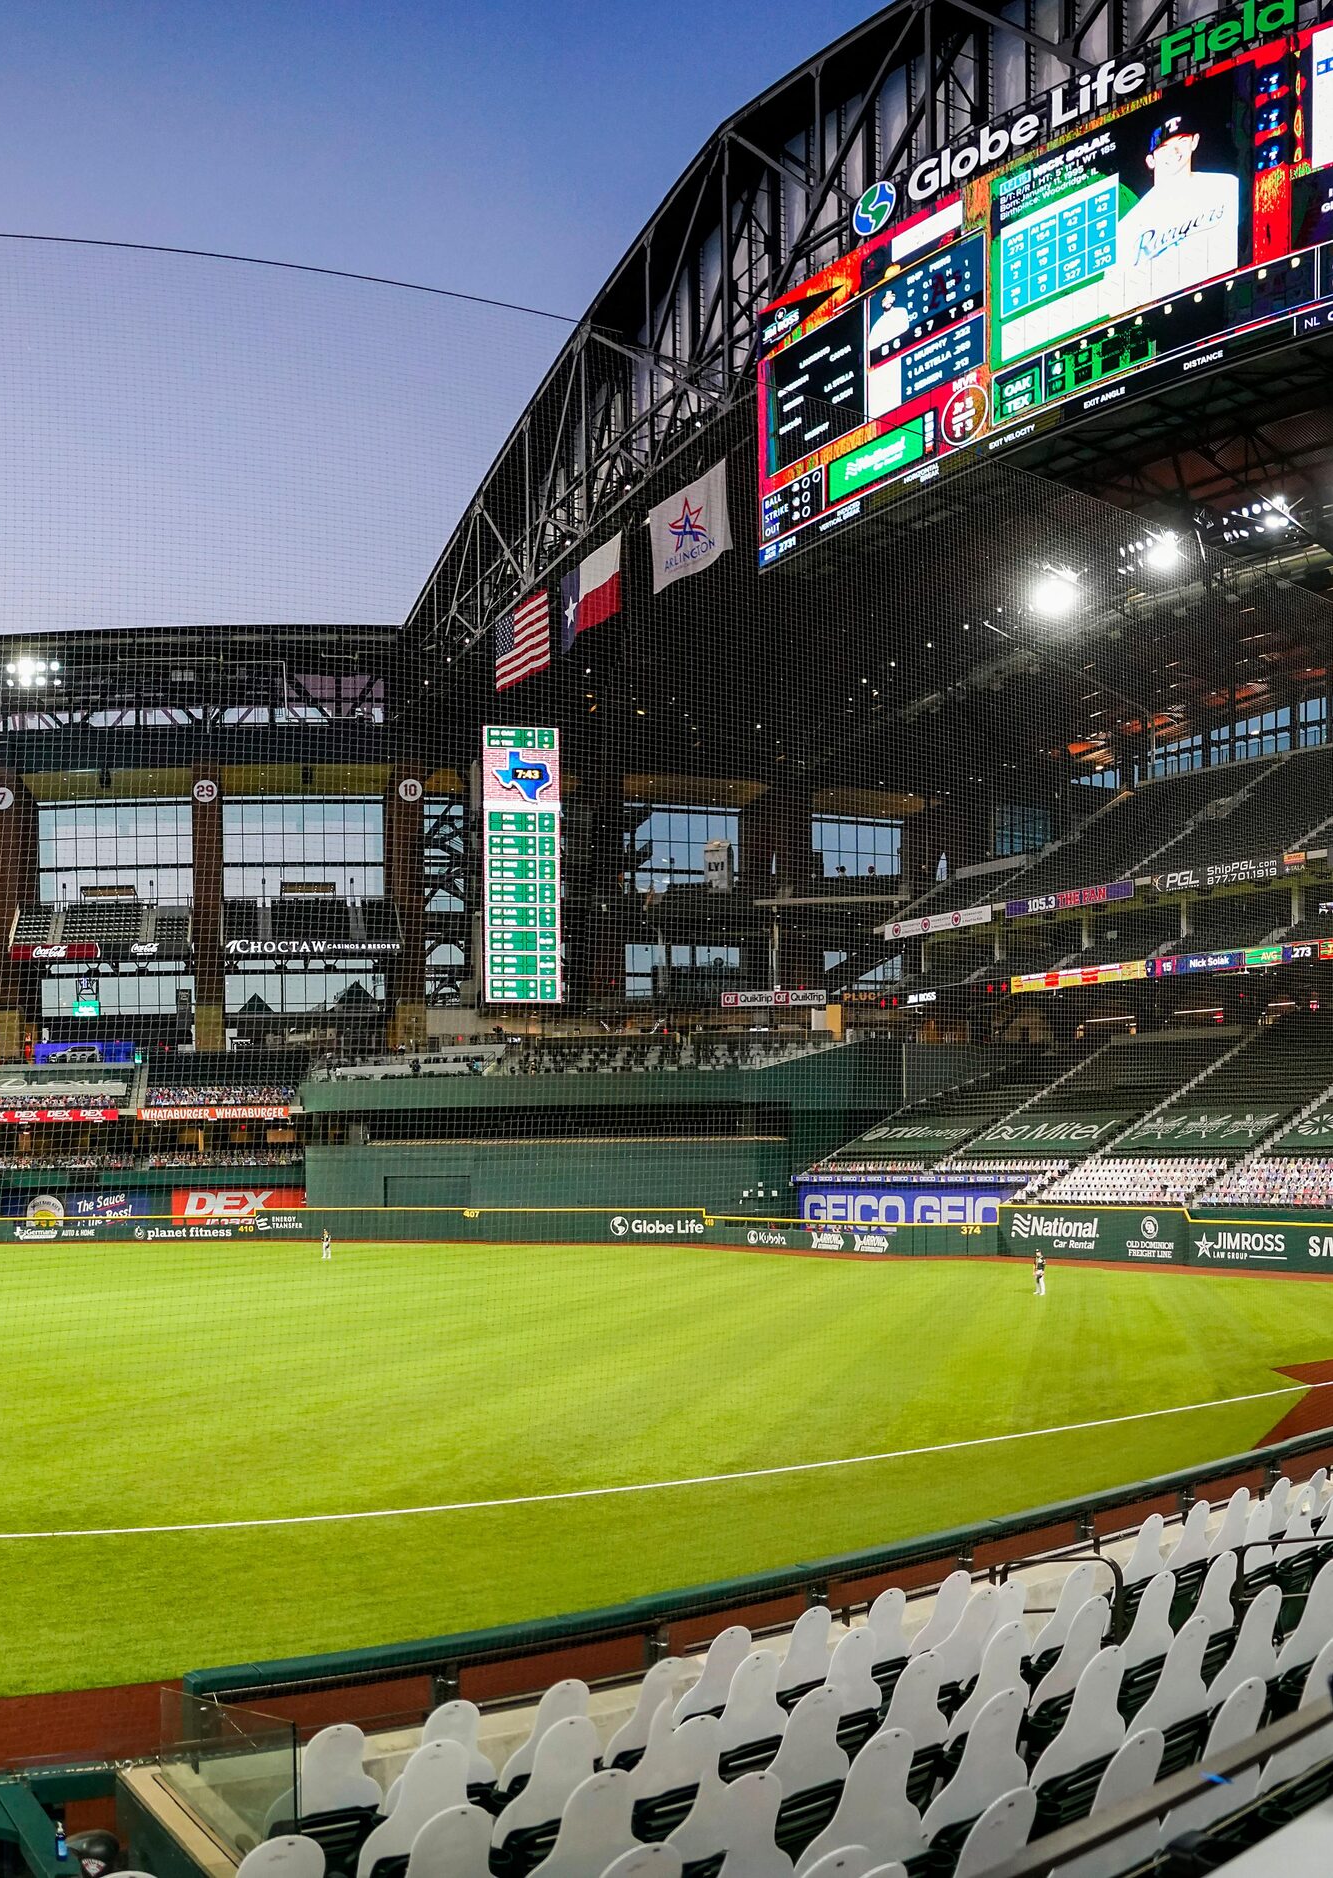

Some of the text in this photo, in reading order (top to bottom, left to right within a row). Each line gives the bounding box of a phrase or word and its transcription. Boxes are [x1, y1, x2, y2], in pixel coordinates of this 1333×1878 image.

[907, 0, 1296, 202] Globe Life Field
[1033, 132, 1111, 177] NICK SOLAK
[1022, 166, 1085, 205] January 1995
[1093, 255, 1112, 269] .370
[1063, 268, 1082, 283] .327
[914, 337, 948, 362] MURPHY
[924, 352, 952, 371] STELLA
[1183, 350, 1224, 371] DISTANCE
[952, 371, 979, 392] MVR
[1004, 375, 1033, 398] OAK
[1005, 394, 1030, 412] TEX
[1099, 387, 1126, 404] ANGLE
[1003, 424, 1035, 445] VELOCITY
[904, 463, 940, 484] HORIZONTAL
[765, 493, 782, 509] BALL
[765, 503, 789, 523] STRIKE
[765, 522, 781, 538] OUT
[778, 536, 797, 553] 2731
[664, 537, 715, 573] ARLINGTON
[516, 770, 540, 779] 7:43
[197, 785, 214, 797] 29
[403, 784, 417, 796] 10
[1165, 871, 1200, 889] PGL
[1206, 858, 1277, 877] ShipPGL.com
[1207, 867, 1277, 886] 877.701.1919
[1027, 886, 1107, 913] 105.3 THE FAN
[236, 940, 326, 953] CHOCTAW
[1291, 946, 1311, 958] .273
[1189, 956, 1230, 968] Nick Solak
[740, 991, 824, 1004] QuikTrip QuikTrip
[14, 1110, 38, 1118] DEX
[47, 1110, 71, 1118] DEX
[80, 1109, 104, 1117] DEX
[141, 1107, 284, 1120] WHATABURGER WHATABURGER
[1021, 1120, 1117, 1140] Mitel
[77, 1200, 94, 1213] The
[96, 1193, 125, 1209] Sauce
[185, 1192, 273, 1217] DEX
[106, 1205, 133, 1222] Boss!
[804, 1194, 905, 1232] GEICO
[26, 1228, 95, 1237] Germania AUTO HOME
[147, 1226, 232, 1240] planet fitness
[631, 1219, 704, 1234] Globe Life
[961, 1226, 981, 1235] 374
[758, 1231, 786, 1245] Kubota
[1053, 1239, 1095, 1250] Car Rental
[1126, 1240, 1174, 1250] OLD DOMINION
[1128, 1249, 1173, 1259] FREIGHT LINE
[1213, 1251, 1248, 1260] LAW GROUP
